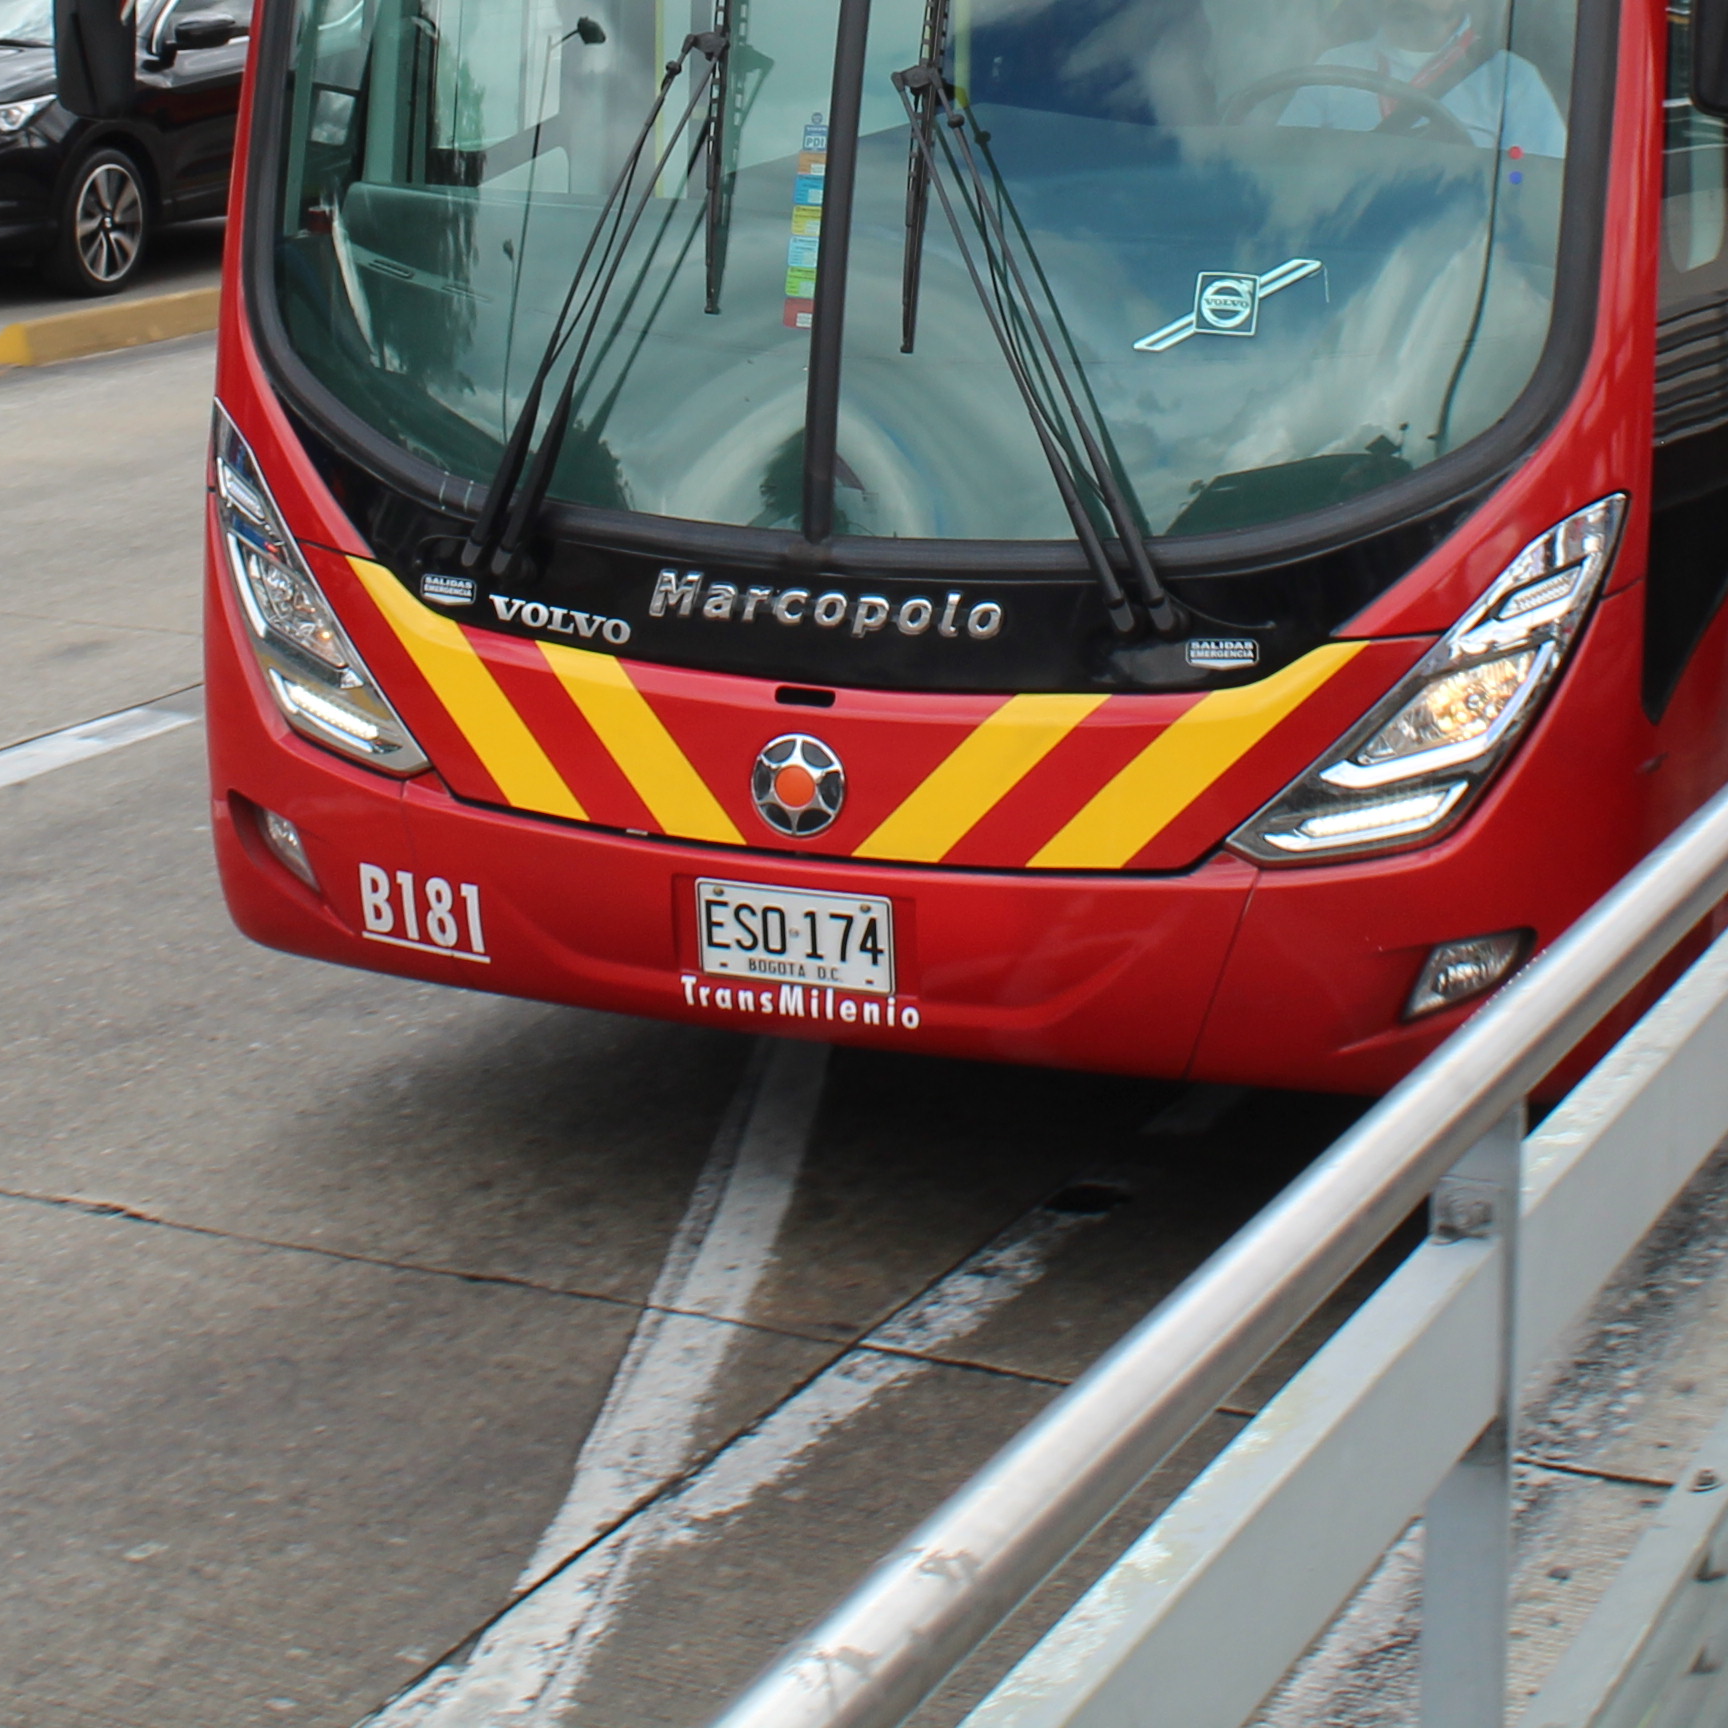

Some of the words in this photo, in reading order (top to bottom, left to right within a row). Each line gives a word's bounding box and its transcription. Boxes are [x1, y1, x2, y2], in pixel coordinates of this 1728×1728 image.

[806, 136, 825, 148] PDI
[1203, 297, 1250, 309] VOLVO
[423, 583, 473, 597] EMERGENCIA
[424, 575, 473, 590] SALIDAS
[648, 568, 1003, 639] Marcopolo
[488, 593, 632, 644] VOLVO
[1190, 641, 1254, 650] SALIDAS
[1189, 649, 1255, 659] EMERGENCIA
[359, 862, 486, 954] B181
[747, 957, 806, 978] BOGOTA
[680, 974, 921, 1030] TransMilenio
